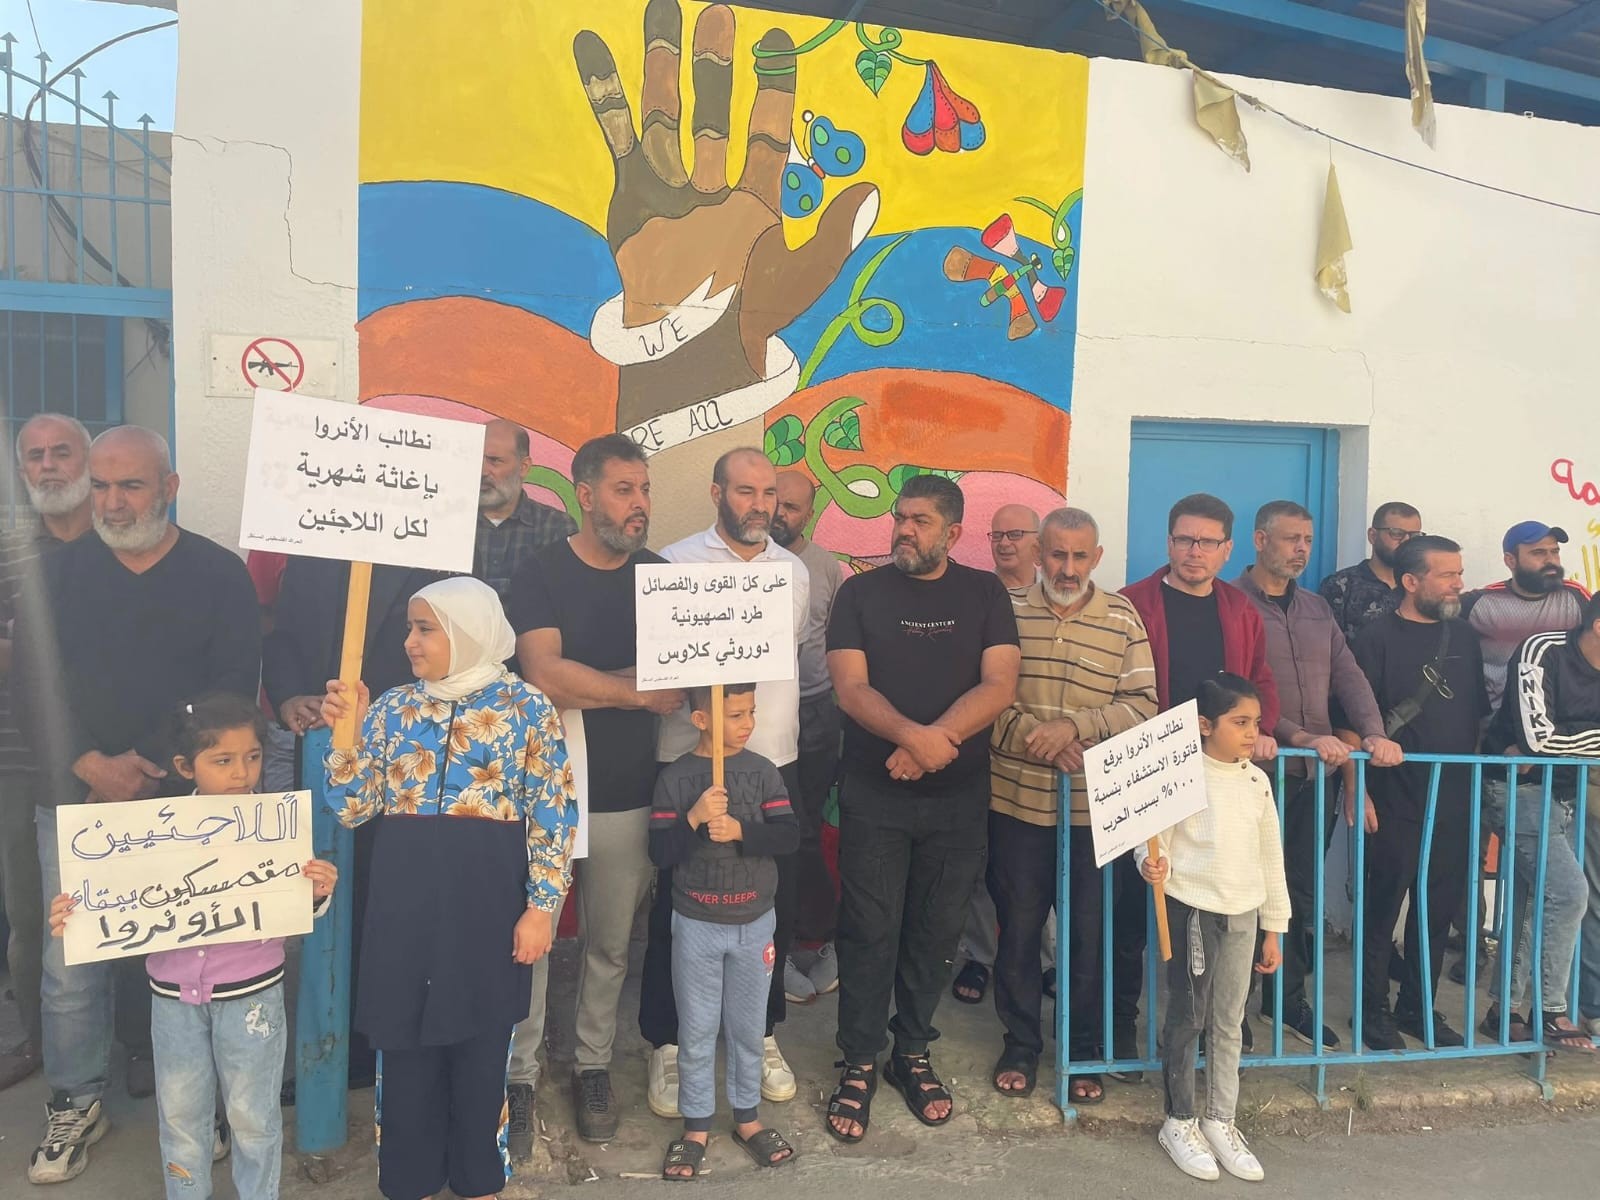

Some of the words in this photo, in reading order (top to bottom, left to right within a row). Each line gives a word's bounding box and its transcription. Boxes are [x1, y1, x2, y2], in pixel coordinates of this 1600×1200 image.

[639, 316, 688, 356] WE
[315, 415, 369, 441] الأنروا
[378, 428, 432, 449] نطالب
[631, 419, 664, 451] RE
[296, 451, 366, 488] شهرية
[375, 463, 438, 499] بإغاثة
[298, 508, 383, 533] اللاجئين
[394, 515, 428, 540] لكل
[642, 576, 699, 595] والفصائل
[704, 575, 737, 593] القوى
[763, 574, 788, 593] على
[671, 606, 735, 626] الصهيونية
[741, 605, 763, 623] طرد
[901, 620, 926, 628] ANCIENT
[927, 620, 955, 628] CENTURY
[657, 641, 711, 664] كلاوس
[715, 637, 770, 666] دوروثي
[1157, 717, 1184, 742] نطالب
[1126, 731, 1153, 759] الأنروا
[1172, 739, 1199, 766] فاتورة
[1103, 750, 1123, 774] برفع
[1126, 755, 1169, 788] الاستشفاء
[1094, 781, 1122, 805] بنسبة
[1133, 794, 1160, 817] بسبب
[1102, 805, 1130, 833] الحرب
[139, 858, 300, 908] متمسكين
[97, 901, 262, 950] الأونروا
